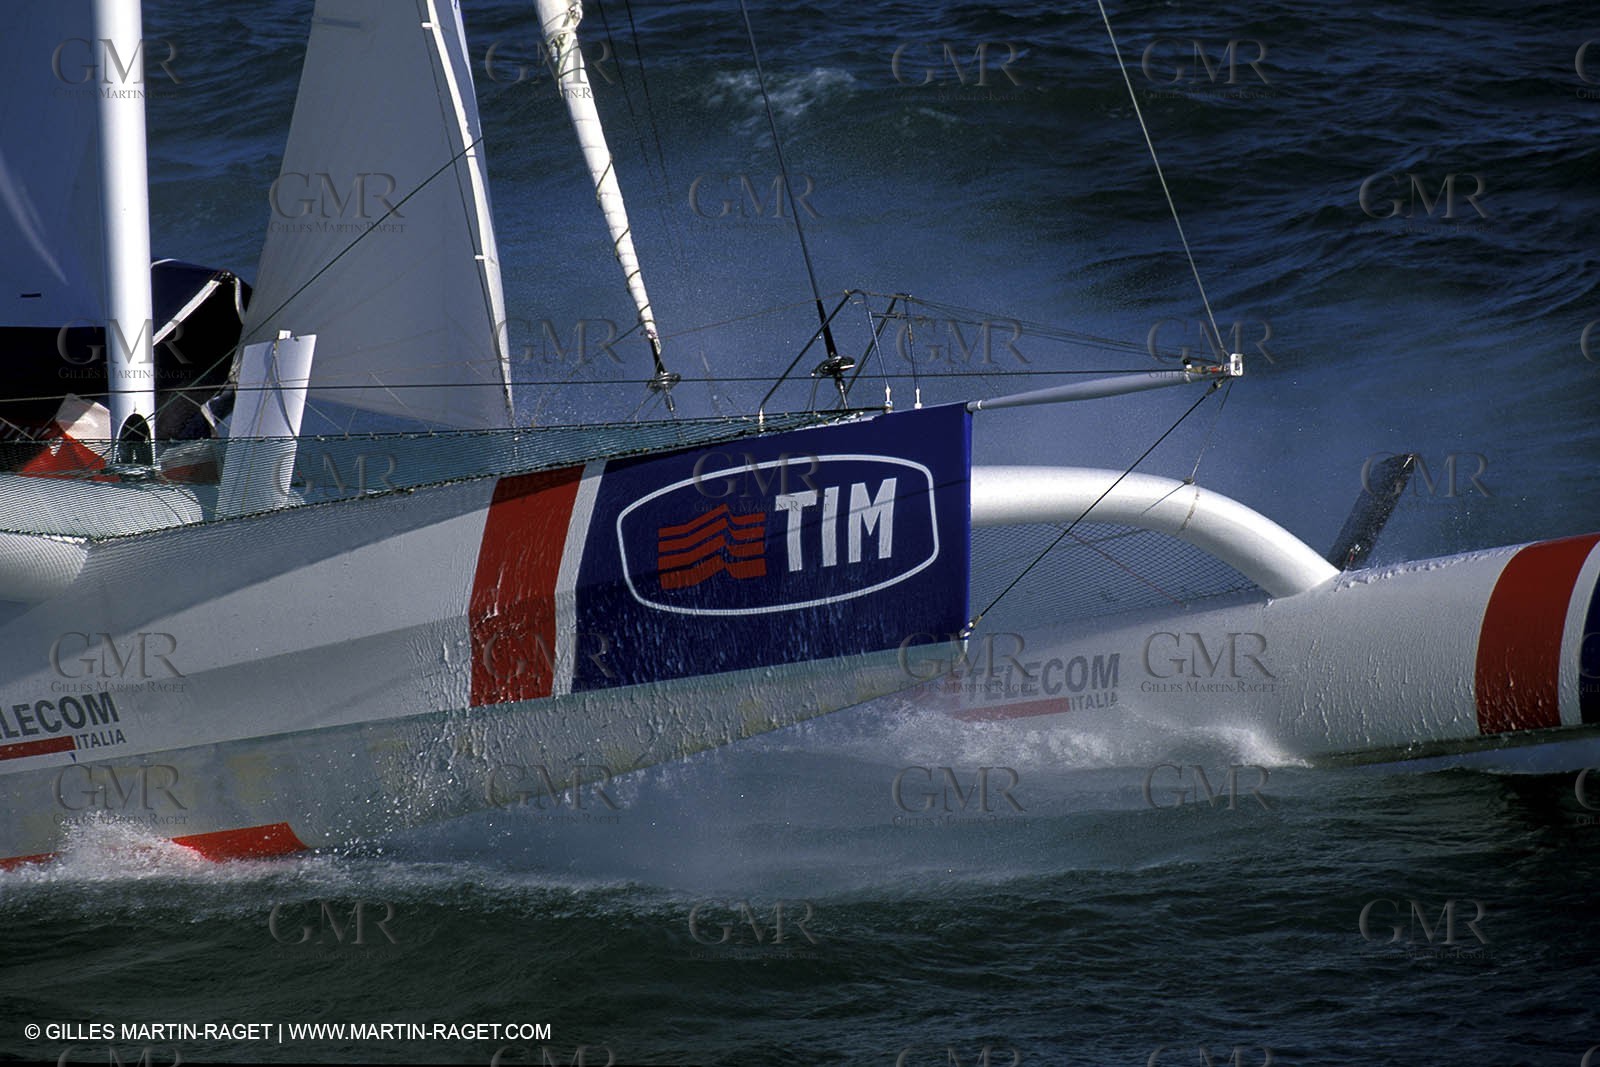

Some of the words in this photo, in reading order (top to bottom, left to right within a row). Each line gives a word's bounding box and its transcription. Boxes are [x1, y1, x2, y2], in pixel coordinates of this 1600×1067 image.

[775, 478, 897, 572] TIM
[0, 691, 119, 739] LECOM
[75, 728, 127, 750] ITALIA
